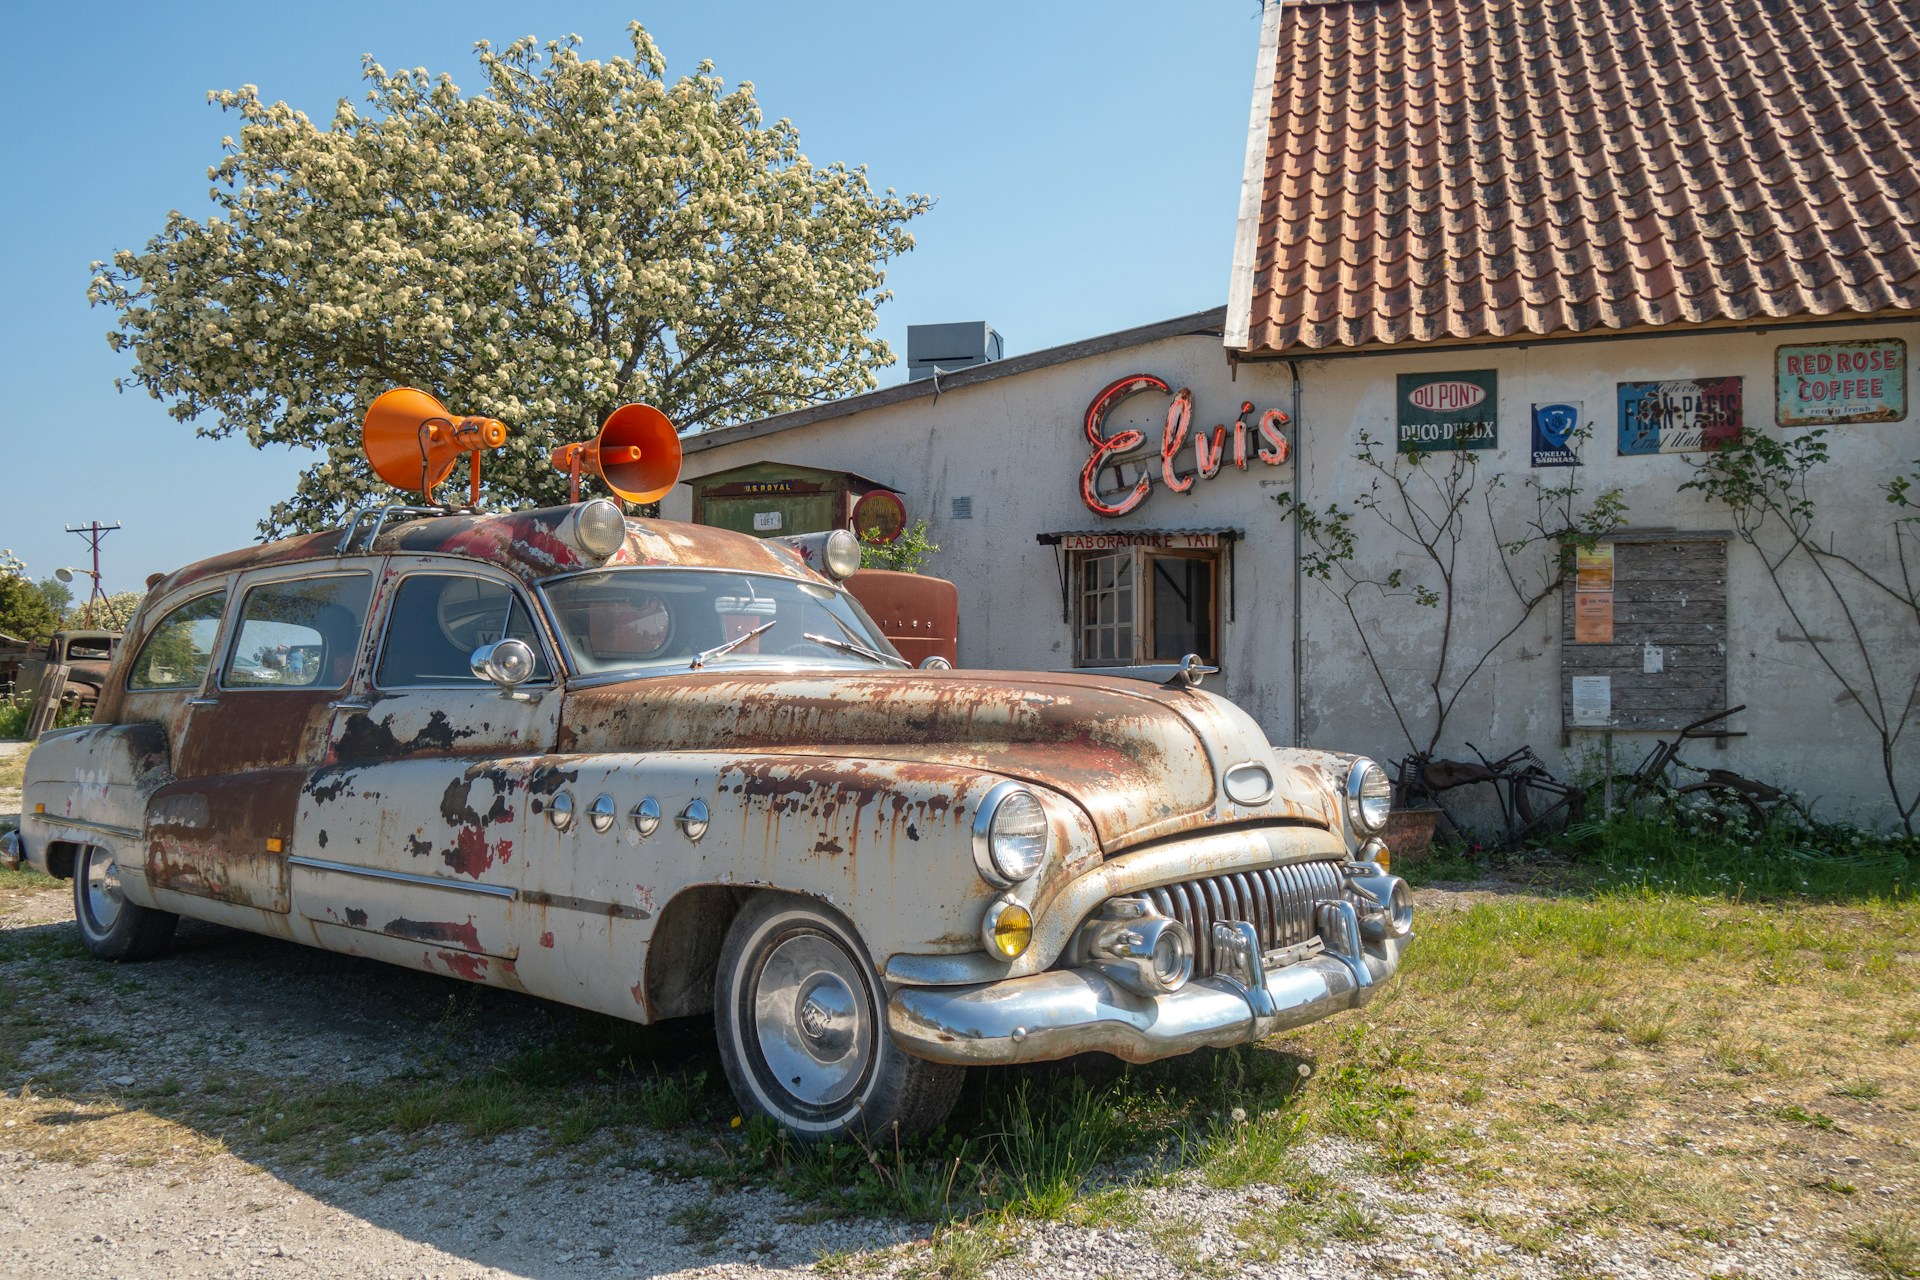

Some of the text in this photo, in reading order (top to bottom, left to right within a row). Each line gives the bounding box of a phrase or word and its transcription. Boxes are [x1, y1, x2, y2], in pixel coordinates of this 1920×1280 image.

[1787, 350, 1896, 375] RED ROSE
[1414, 384, 1480, 408] DU PONT
[1798, 378, 1884, 401] COFFEE
[1844, 405, 1871, 413] fresh
[1079, 373, 1292, 518] Elvis
[1533, 450, 1567, 458] CYKELN
[760, 483, 790, 491] ROYAL
[760, 518, 774, 526] LUFT
[1066, 533, 1215, 549] LABORATOIRE TATI
